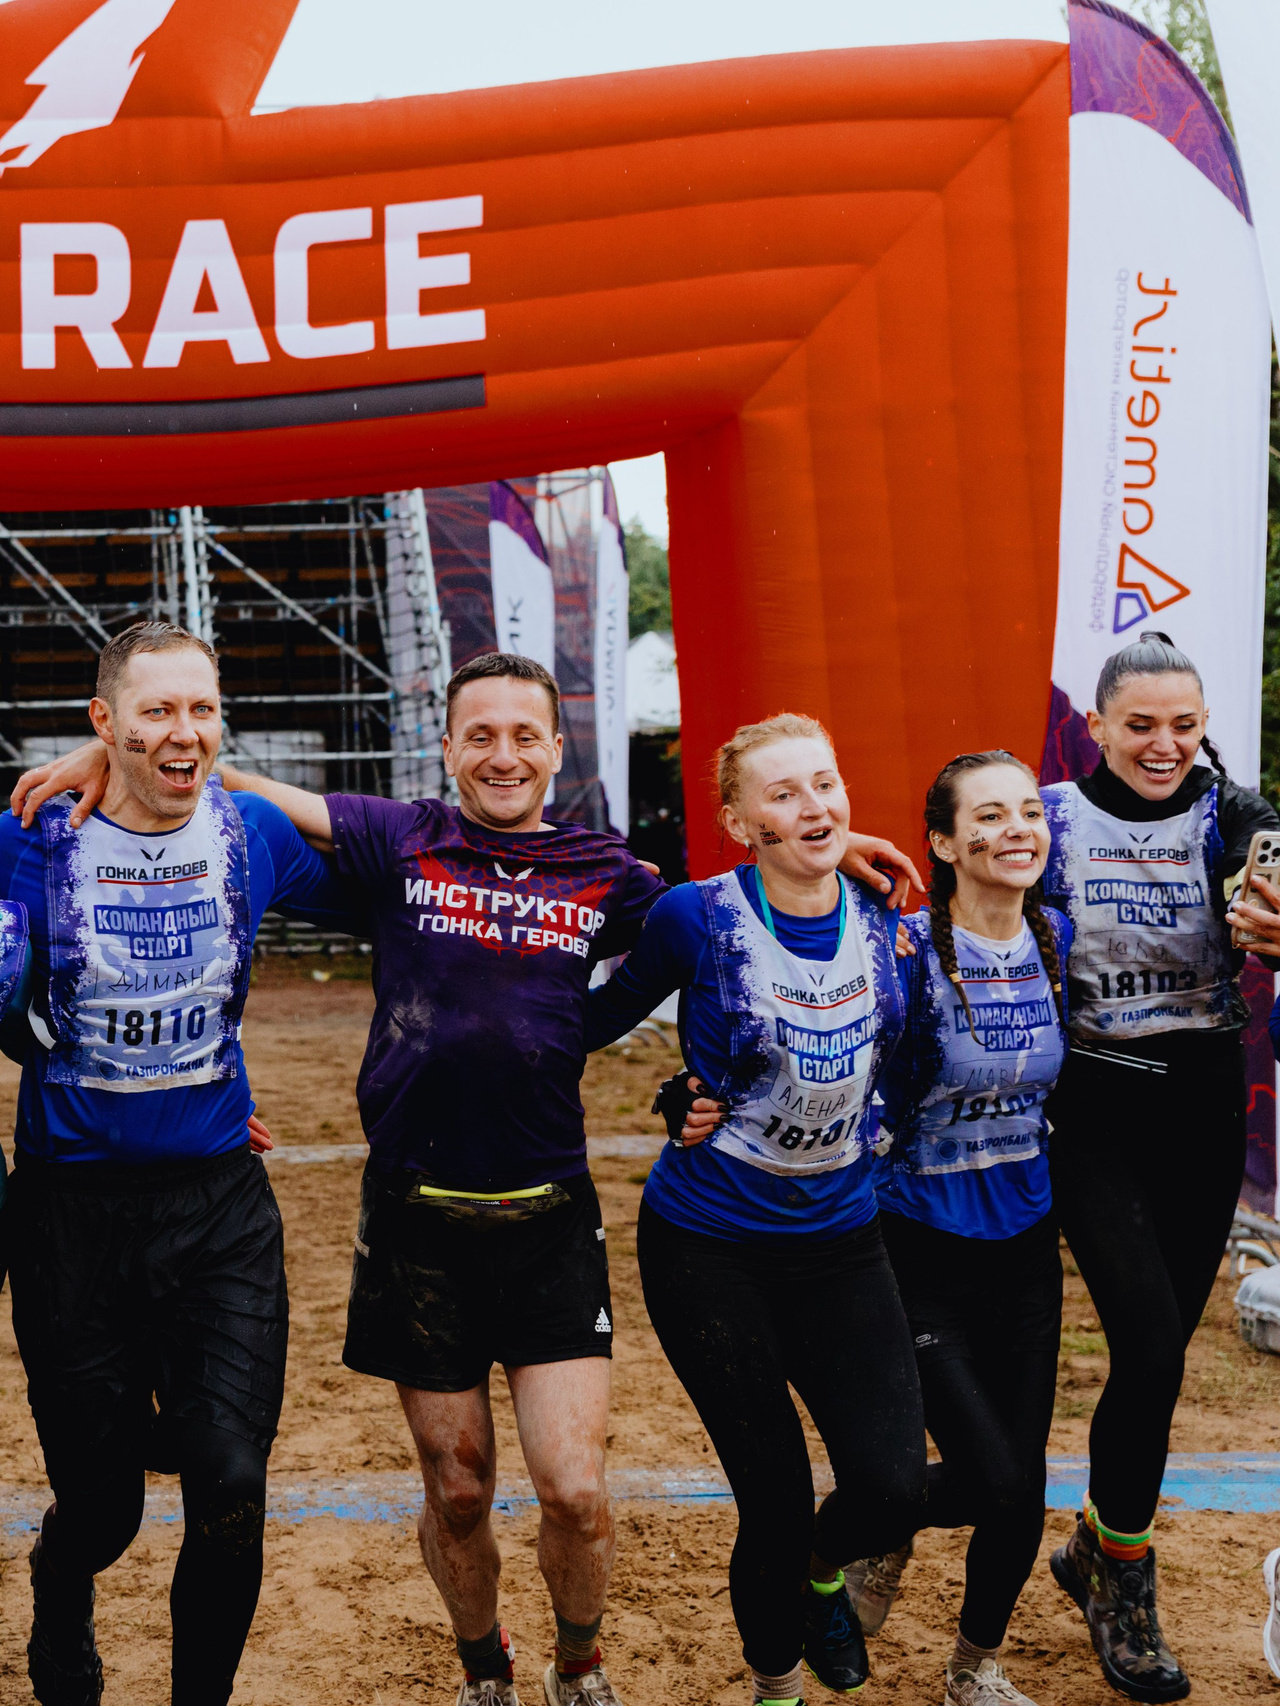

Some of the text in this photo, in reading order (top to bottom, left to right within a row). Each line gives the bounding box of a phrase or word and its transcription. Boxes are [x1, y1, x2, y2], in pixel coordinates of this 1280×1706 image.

[20, 195, 487, 370] RACE
[1089, 847, 1189, 861] ГОНКА ГЕРОЕВ
[96, 859, 208, 881] ГОНКА ГЕРОЕВ
[404, 878, 606, 936] ИНСТРУКТОР
[1087, 881, 1202, 907] КОМАНДНЫЙ
[96, 897, 216, 936] КОМАНДНЫЙ
[1120, 903, 1173, 925] СТАРТ
[133, 935, 188, 958] СТАРТ
[418, 914, 589, 959] ГОНКА ГЕРОЕВ
[107, 965, 205, 993] ДИМАН
[958, 962, 1039, 979] ОНКА ГЕРОЕВ
[772, 974, 867, 1005] ГОНКА ГЕРОЕВ
[104, 1004, 206, 1046] 18110
[956, 998, 1051, 1029] КОМАНДНЫЙ
[1122, 1006, 1194, 1023] ГАЗПРОМБАНК
[987, 1029, 1031, 1050] СТАРТ
[126, 1056, 205, 1078] ГАЗПРОМБАНК
[802, 1054, 851, 1082] СТАРТ
[778, 1085, 846, 1118] АЛЕНА
[762, 1112, 858, 1150] 18101
